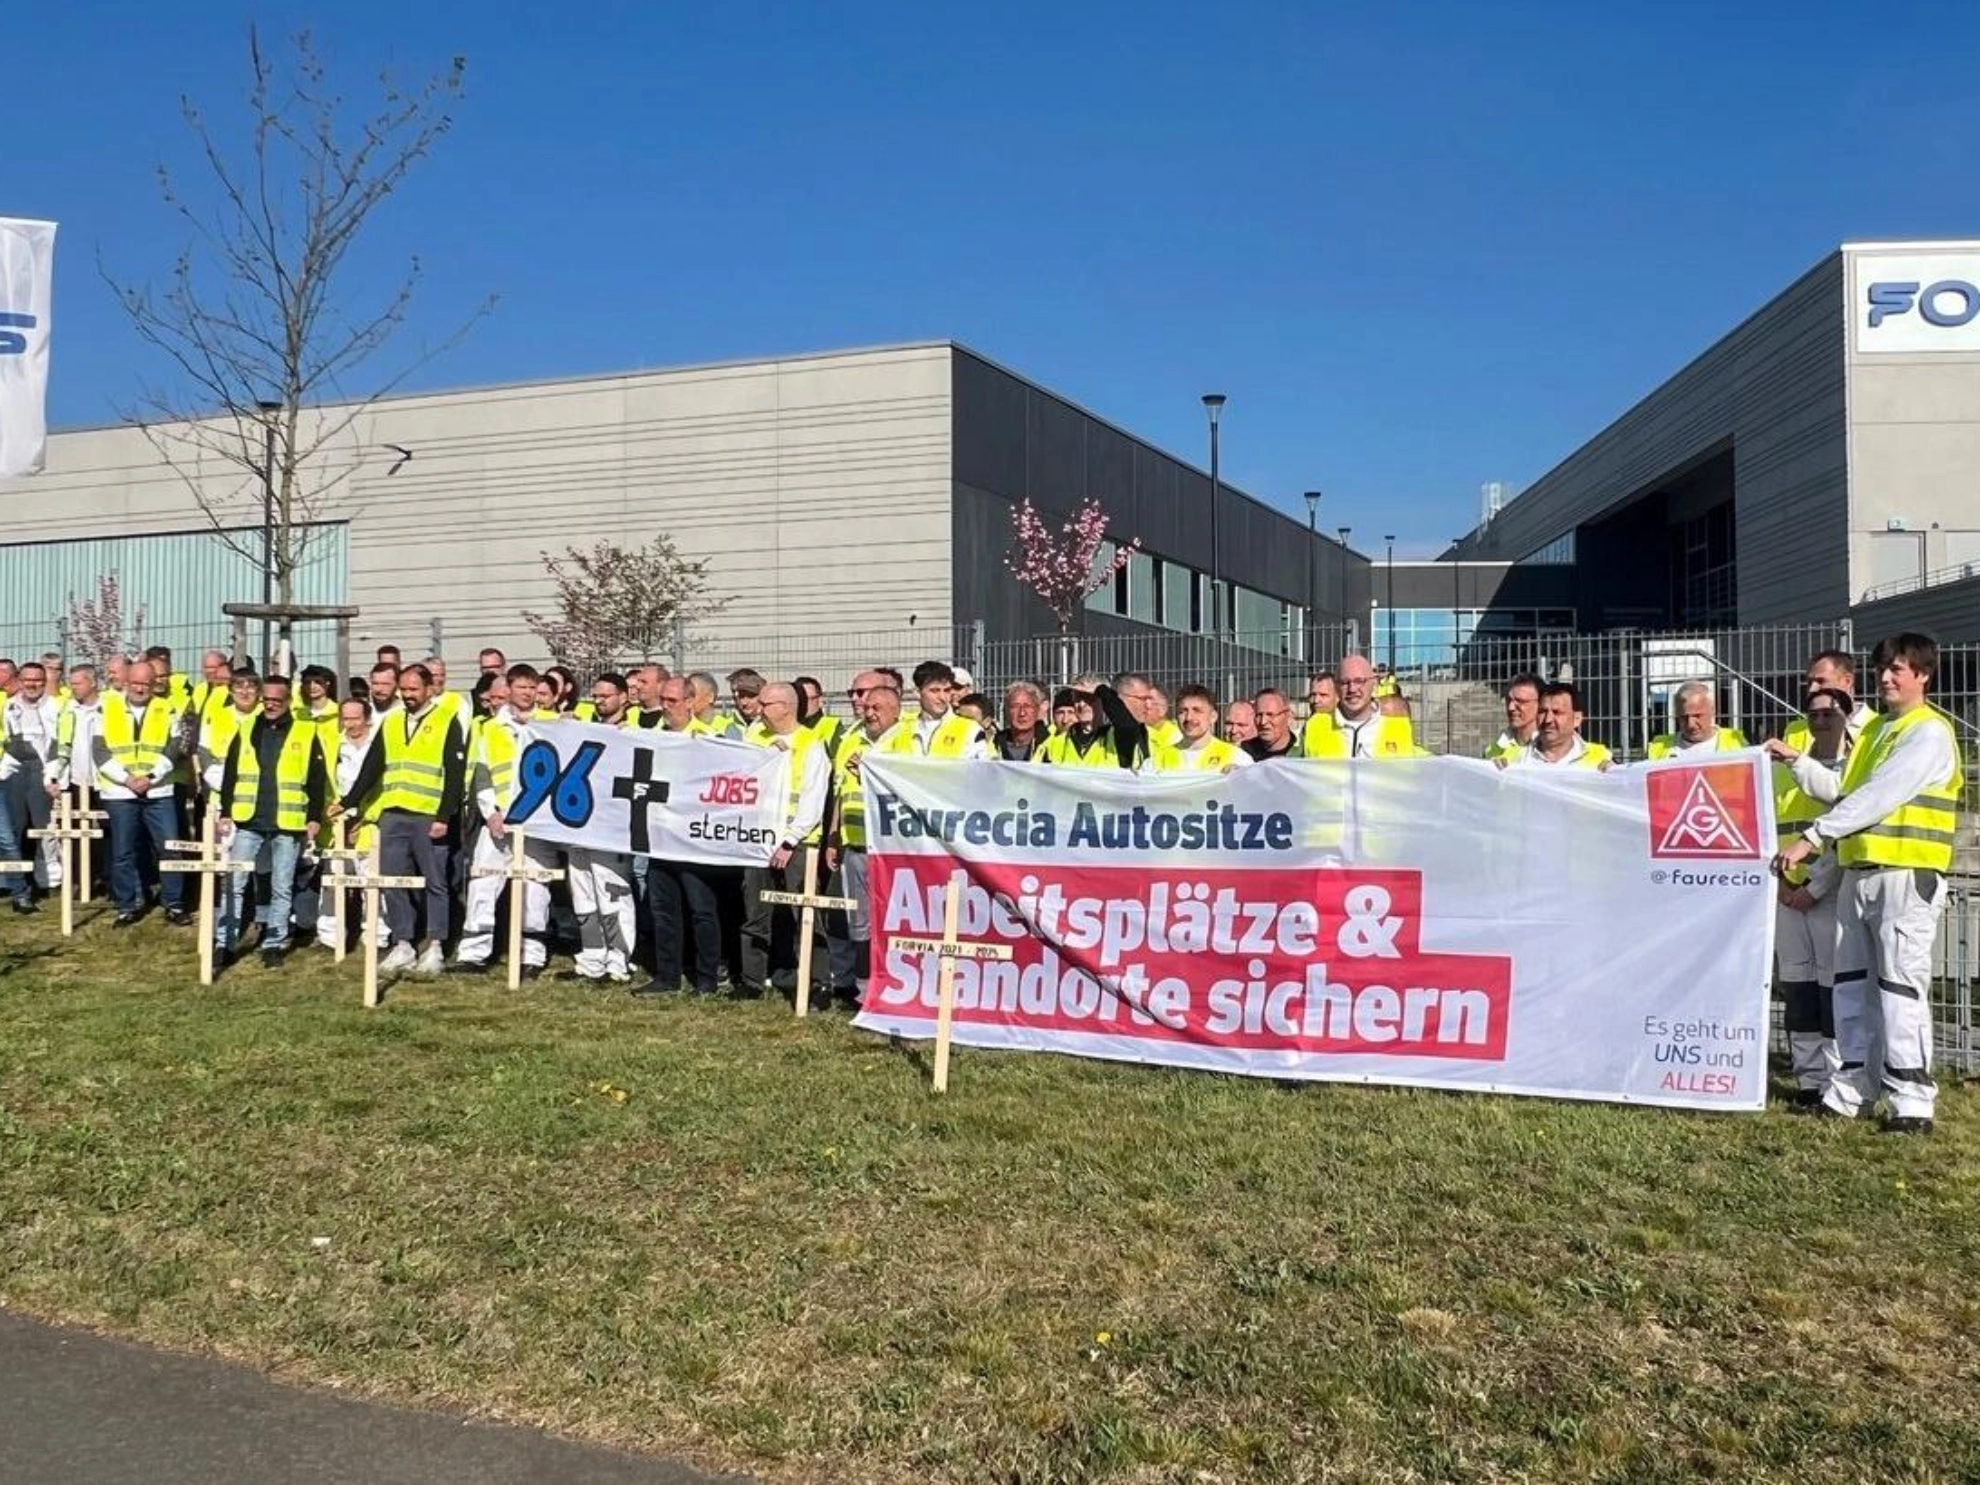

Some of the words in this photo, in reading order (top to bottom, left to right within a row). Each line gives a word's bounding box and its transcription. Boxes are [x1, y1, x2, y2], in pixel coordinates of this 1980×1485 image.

[1868, 280, 1980, 328] FO
[503, 739, 607, 828] 96
[699, 775, 759, 805] JOBS
[689, 813, 776, 846] sterben
[878, 794, 1055, 847] Faurecia
[1067, 799, 1293, 850] Autositze
[883, 868, 1320, 966] Arbeitsplätze
[1337, 884, 1404, 958] &
[895, 940, 935, 953] FORVIA
[880, 945, 1190, 1030] Standorte
[1205, 958, 1489, 1044] sichern
[1644, 1015, 1668, 1036] Es
[1672, 1018, 1720, 1042] geht
[1724, 1026, 1756, 1041] um
[1655, 1043, 1702, 1065] UNS
[1706, 1050, 1743, 1068] und
[1660, 1071, 1736, 1095] ALLES!
